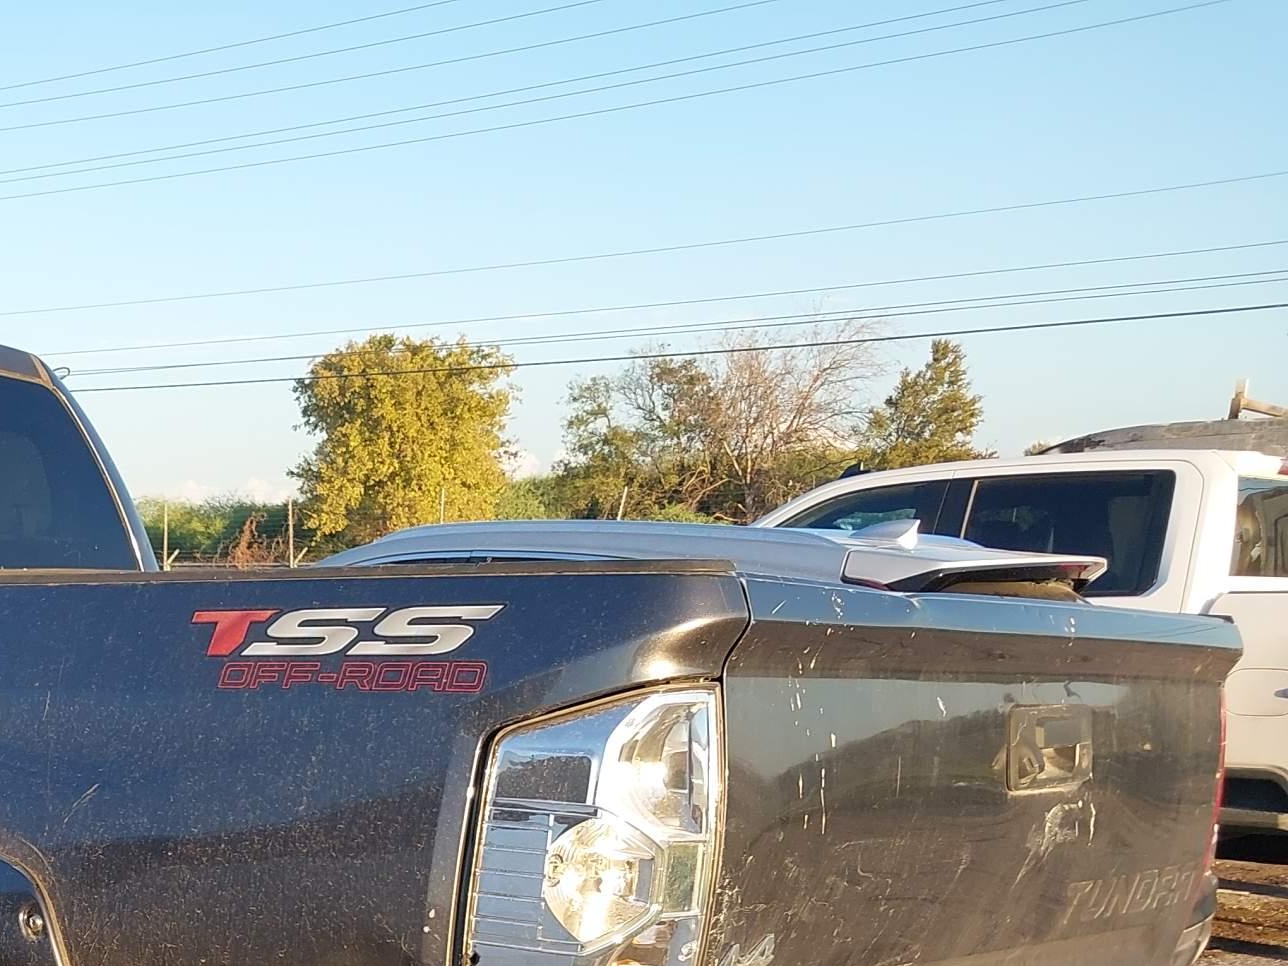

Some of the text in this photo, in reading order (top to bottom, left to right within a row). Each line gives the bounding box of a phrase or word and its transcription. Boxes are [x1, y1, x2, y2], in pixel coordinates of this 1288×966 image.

[191, 604, 508, 657] TSS
[216, 660, 488, 694] OFF-ROAD
[1065, 862, 1197, 925] TUNDRA
